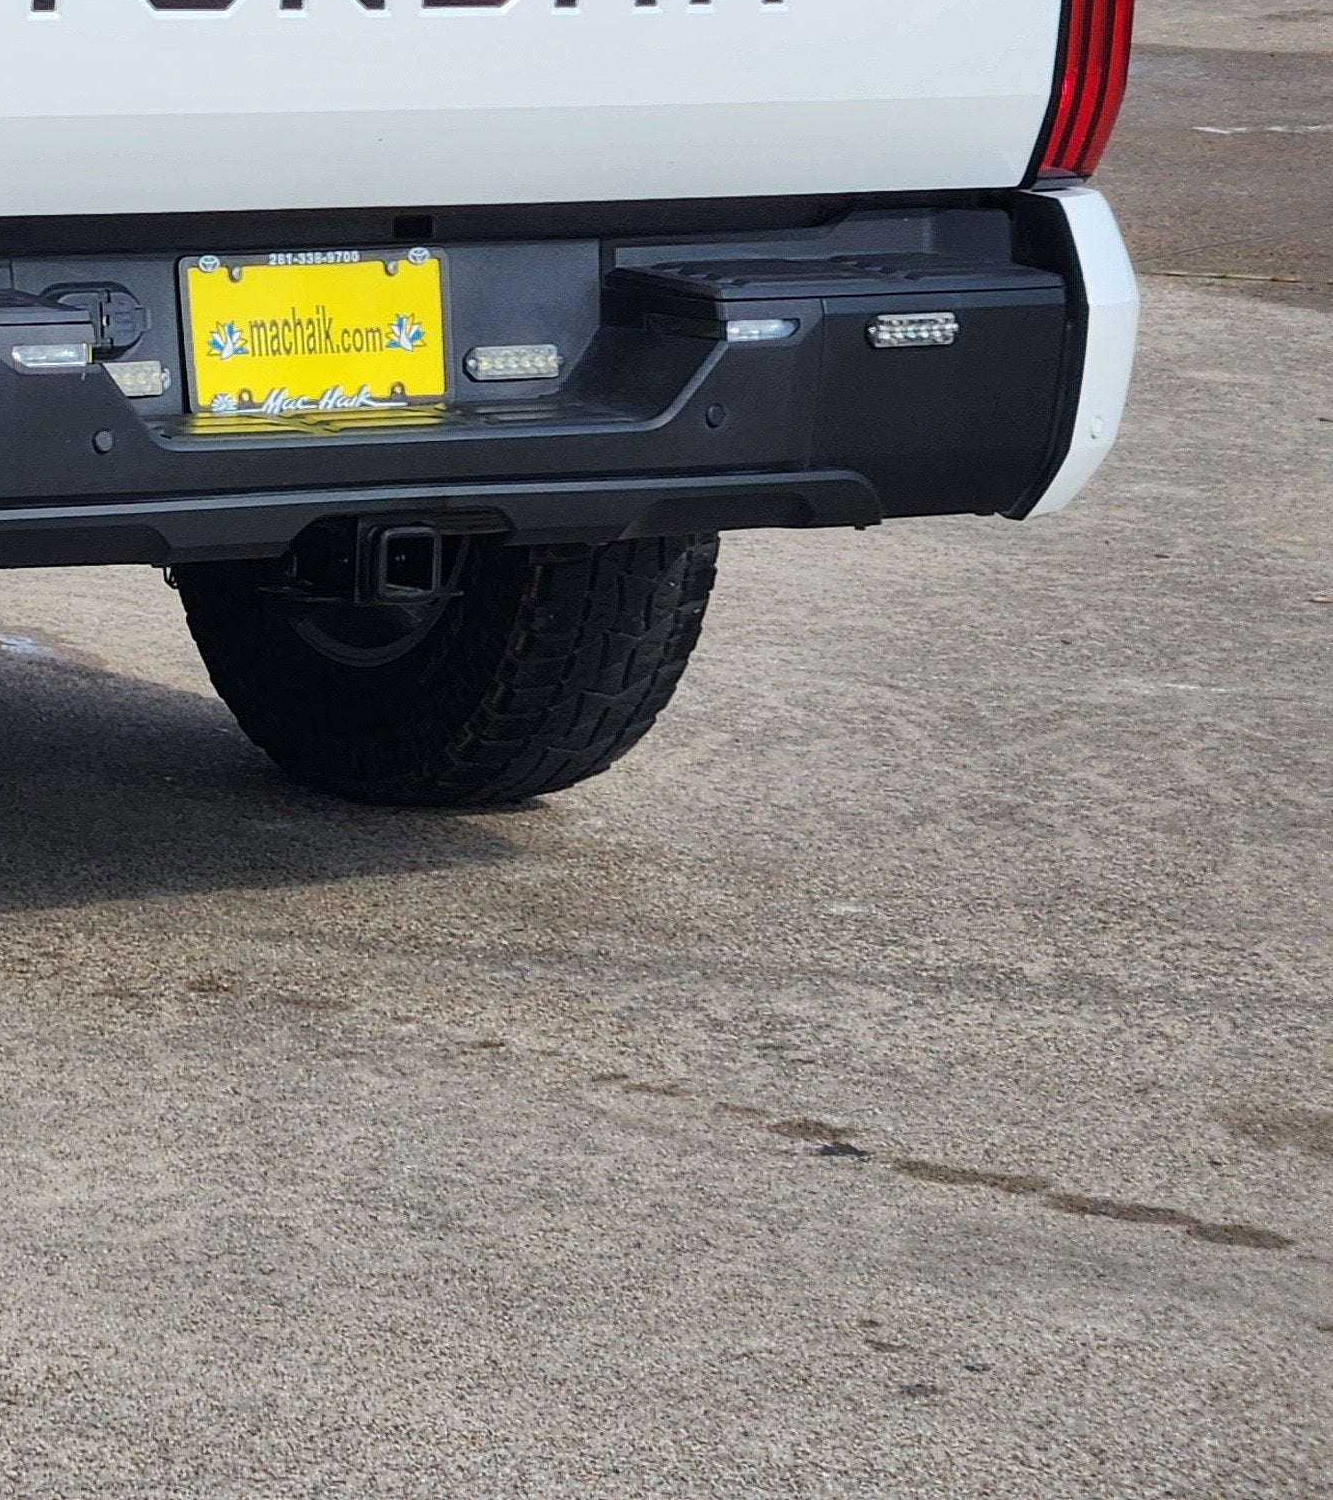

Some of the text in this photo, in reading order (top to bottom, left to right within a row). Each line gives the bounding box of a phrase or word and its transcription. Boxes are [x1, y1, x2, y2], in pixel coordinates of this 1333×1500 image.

[249, 305, 384, 357] machaik.com
[259, 384, 407, 414] Mac Haik
